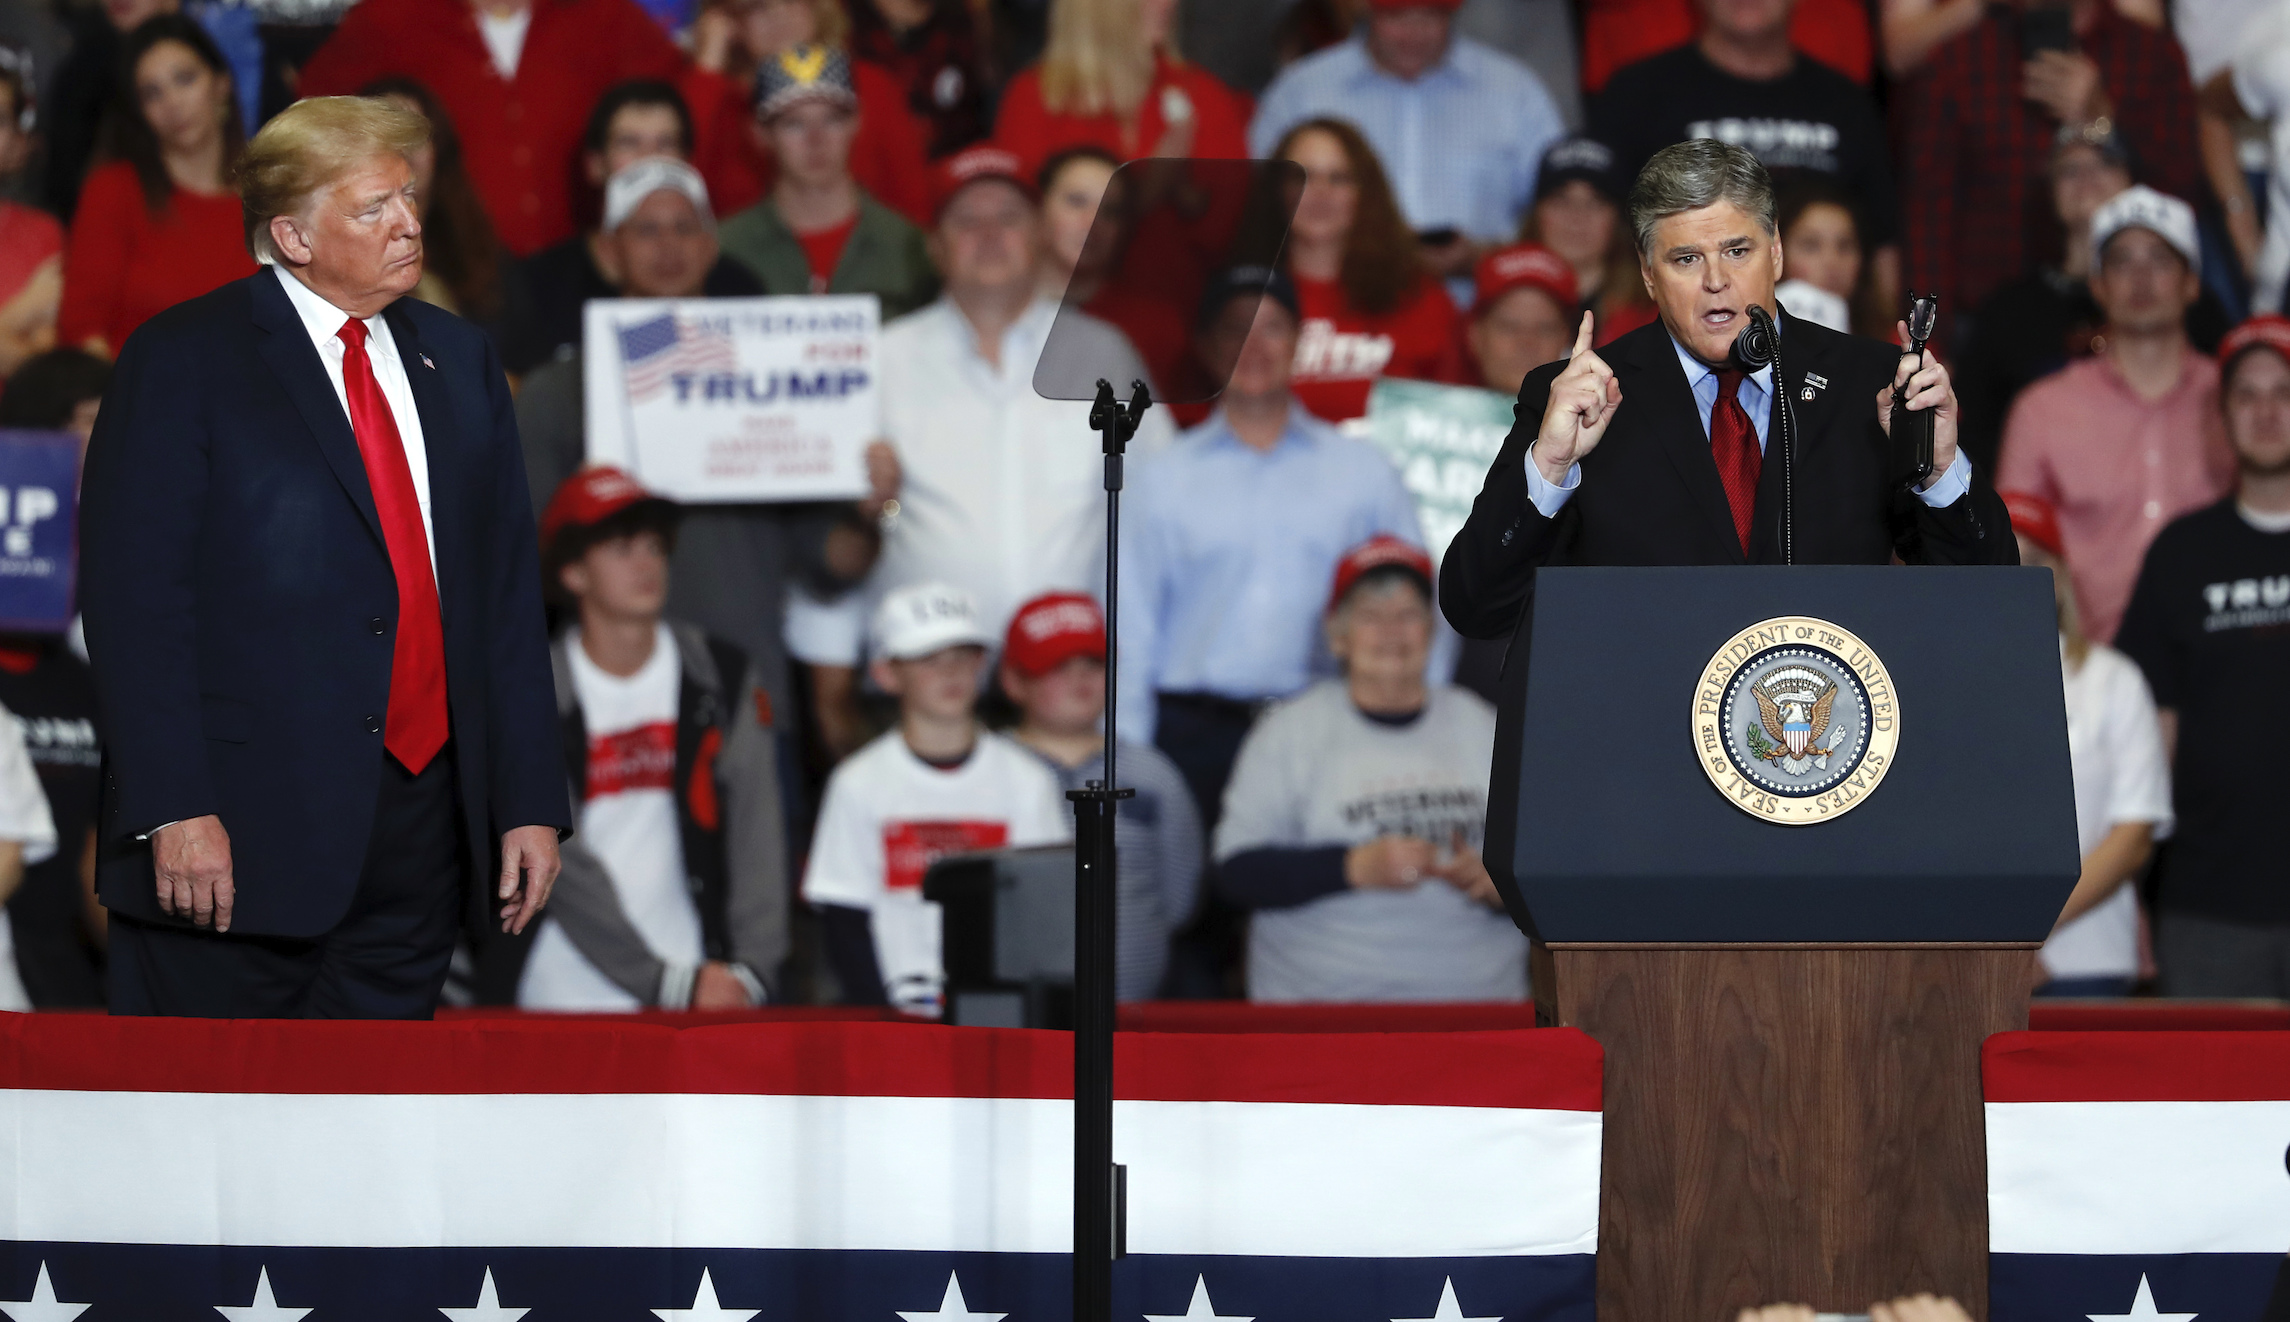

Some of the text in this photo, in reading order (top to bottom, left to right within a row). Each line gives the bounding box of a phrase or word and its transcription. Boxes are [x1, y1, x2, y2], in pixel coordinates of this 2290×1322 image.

[672, 370, 869, 404] TRUMP
[1700, 624, 1893, 814] SEAL OF THE PRESIDENT OF THE UNITED STATES
